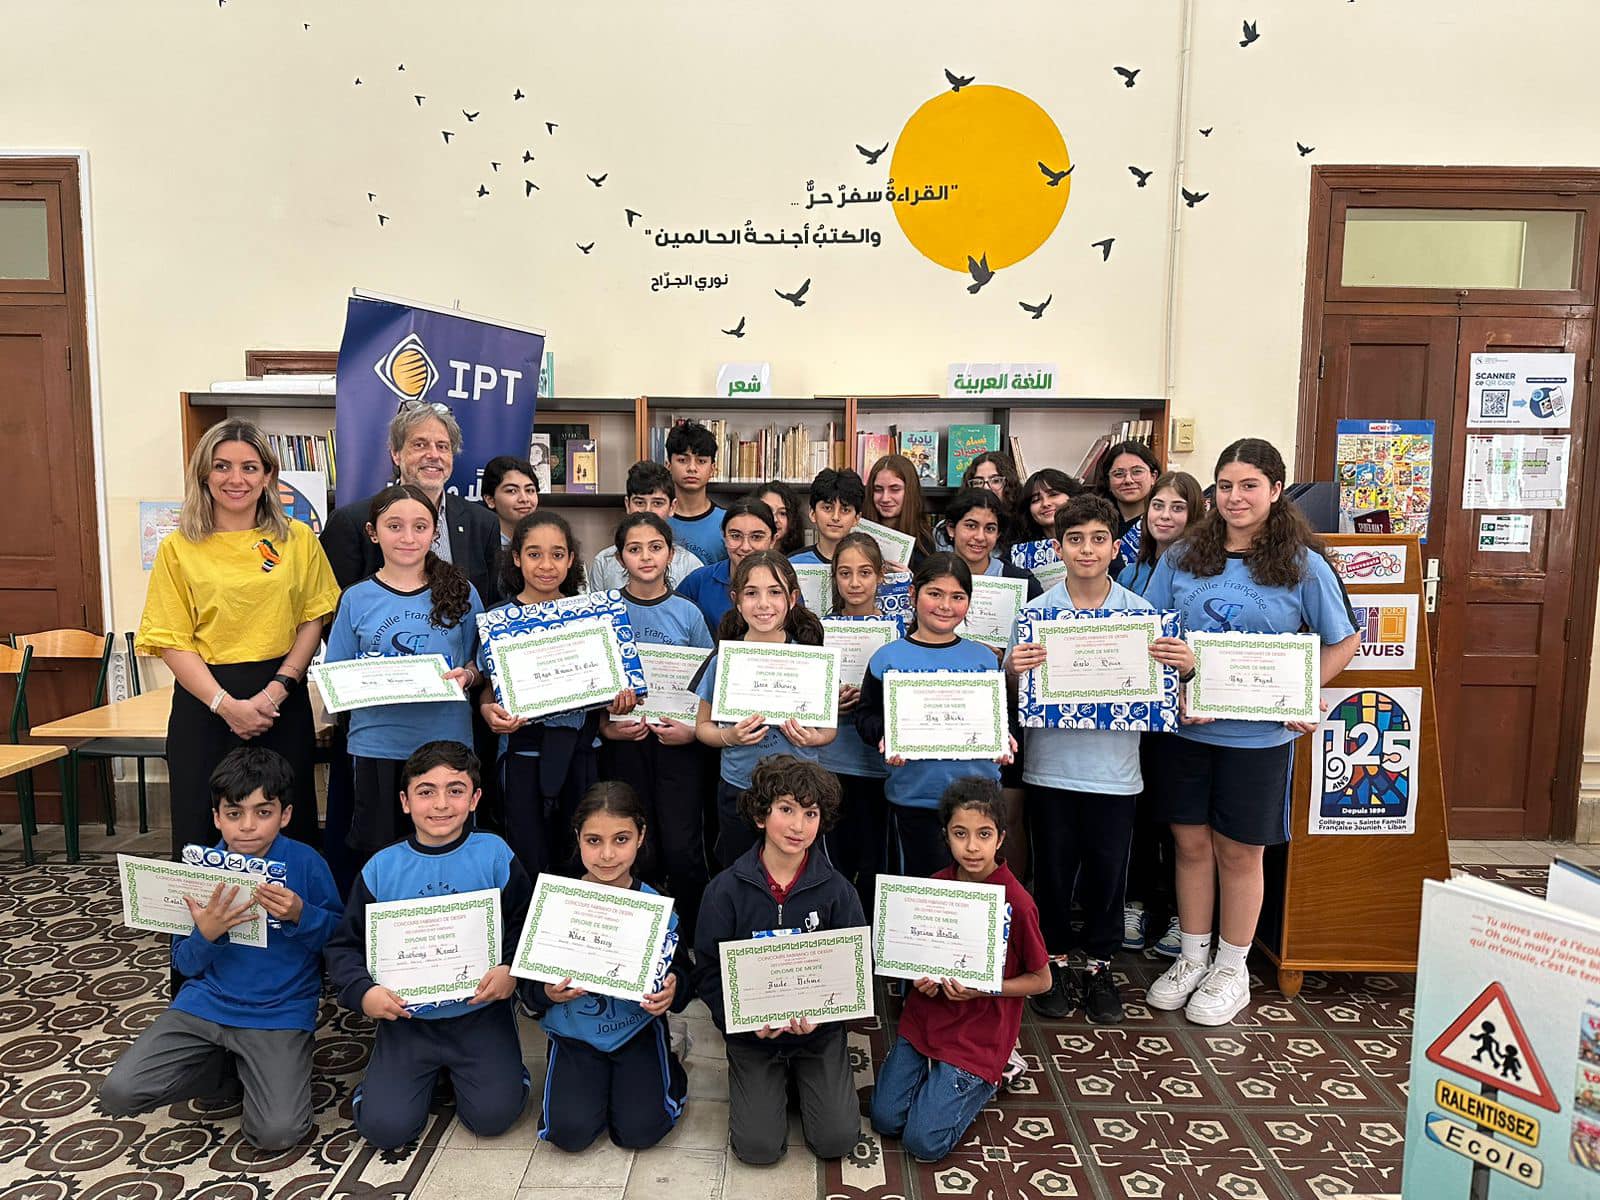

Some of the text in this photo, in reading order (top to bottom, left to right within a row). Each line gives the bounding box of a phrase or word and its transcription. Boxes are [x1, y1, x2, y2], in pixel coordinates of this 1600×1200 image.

[694, 274, 729, 291] نوري
[447, 360, 522, 405] IPT
[728, 375, 761, 396] شعر
[1184, 582, 1220, 607] Famille
[1223, 580, 1267, 610] Française
[371, 615, 401, 646] Famille
[1324, 720, 1411, 776] 125
[1332, 775, 1350, 790] ANS
[1487, 916, 1498, 926] Tu
[1500, 921, 1530, 936] aimes
[1534, 930, 1558, 944] aller
[1470, 938, 1486, 948] qui
[1540, 960, 1564, 972] c'est
[1567, 966, 1578, 976] le
[1485, 928, 1500, 940] Oh
[1502, 934, 1522, 948] oui,
[1524, 942, 1550, 955] mais
[1550, 949, 1586, 966] j'aime
[596, 1013, 642, 1034] Jounieh
[1441, 1087, 1535, 1141] RALENTISSEZ
[1446, 1125, 1533, 1178] Ecole
